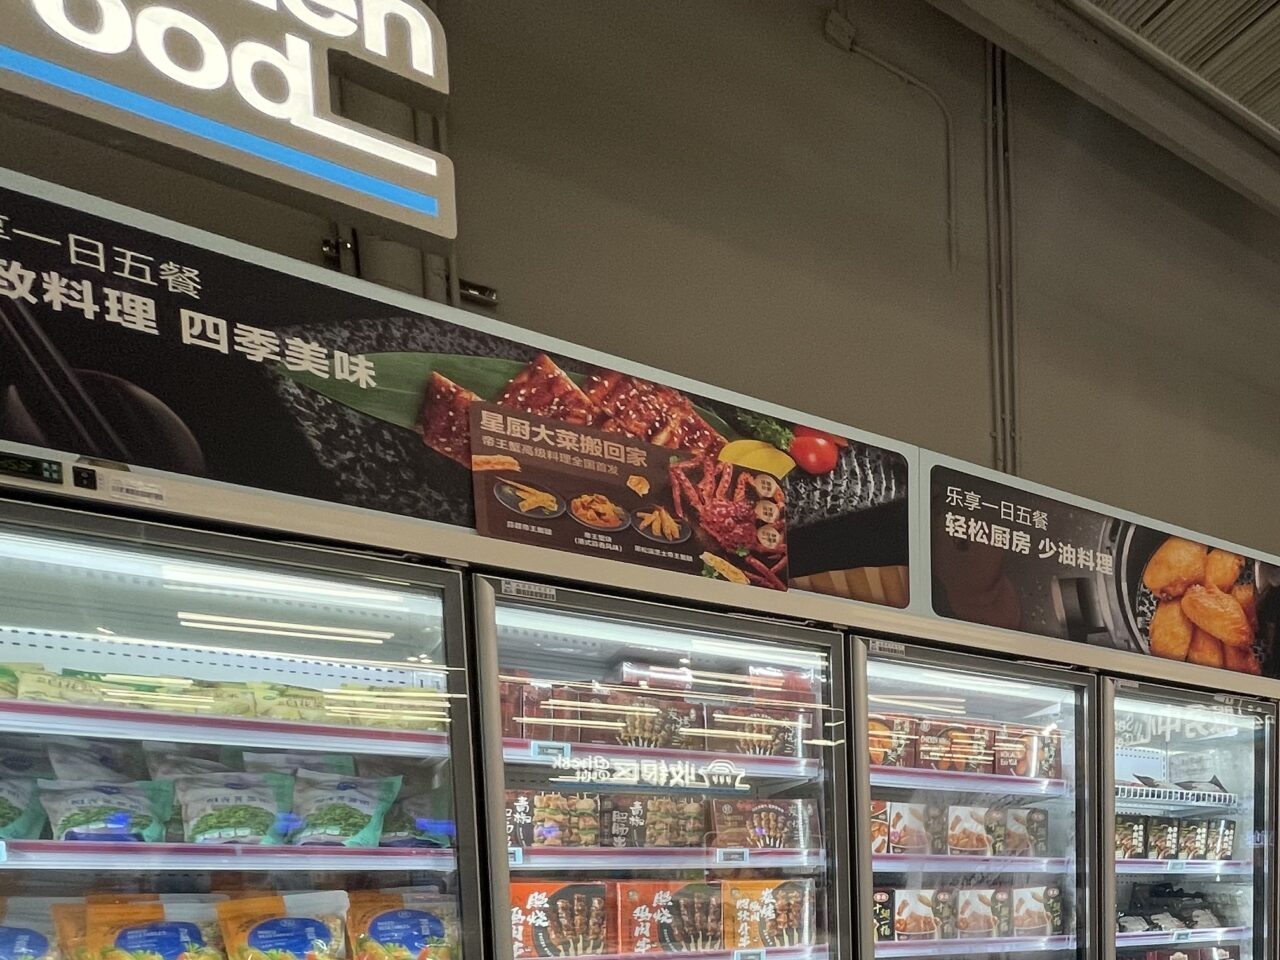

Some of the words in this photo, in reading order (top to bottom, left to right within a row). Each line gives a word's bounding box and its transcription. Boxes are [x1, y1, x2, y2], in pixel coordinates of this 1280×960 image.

[0, 215, 202, 299] 一日五餐
[180, 307, 378, 390] 四季美味
[480, 410, 649, 468] 星厨大菜搬回家
[481, 435, 620, 476] 帝王蟹高级料理全国首发
[945, 486, 1049, 532] 乐享一日五餐
[945, 511, 1031, 556] 轻松厨房
[1038, 538, 1114, 576] 少油料理
[526, 891, 550, 927] 照烧
[653, 891, 674, 924] 照烧
